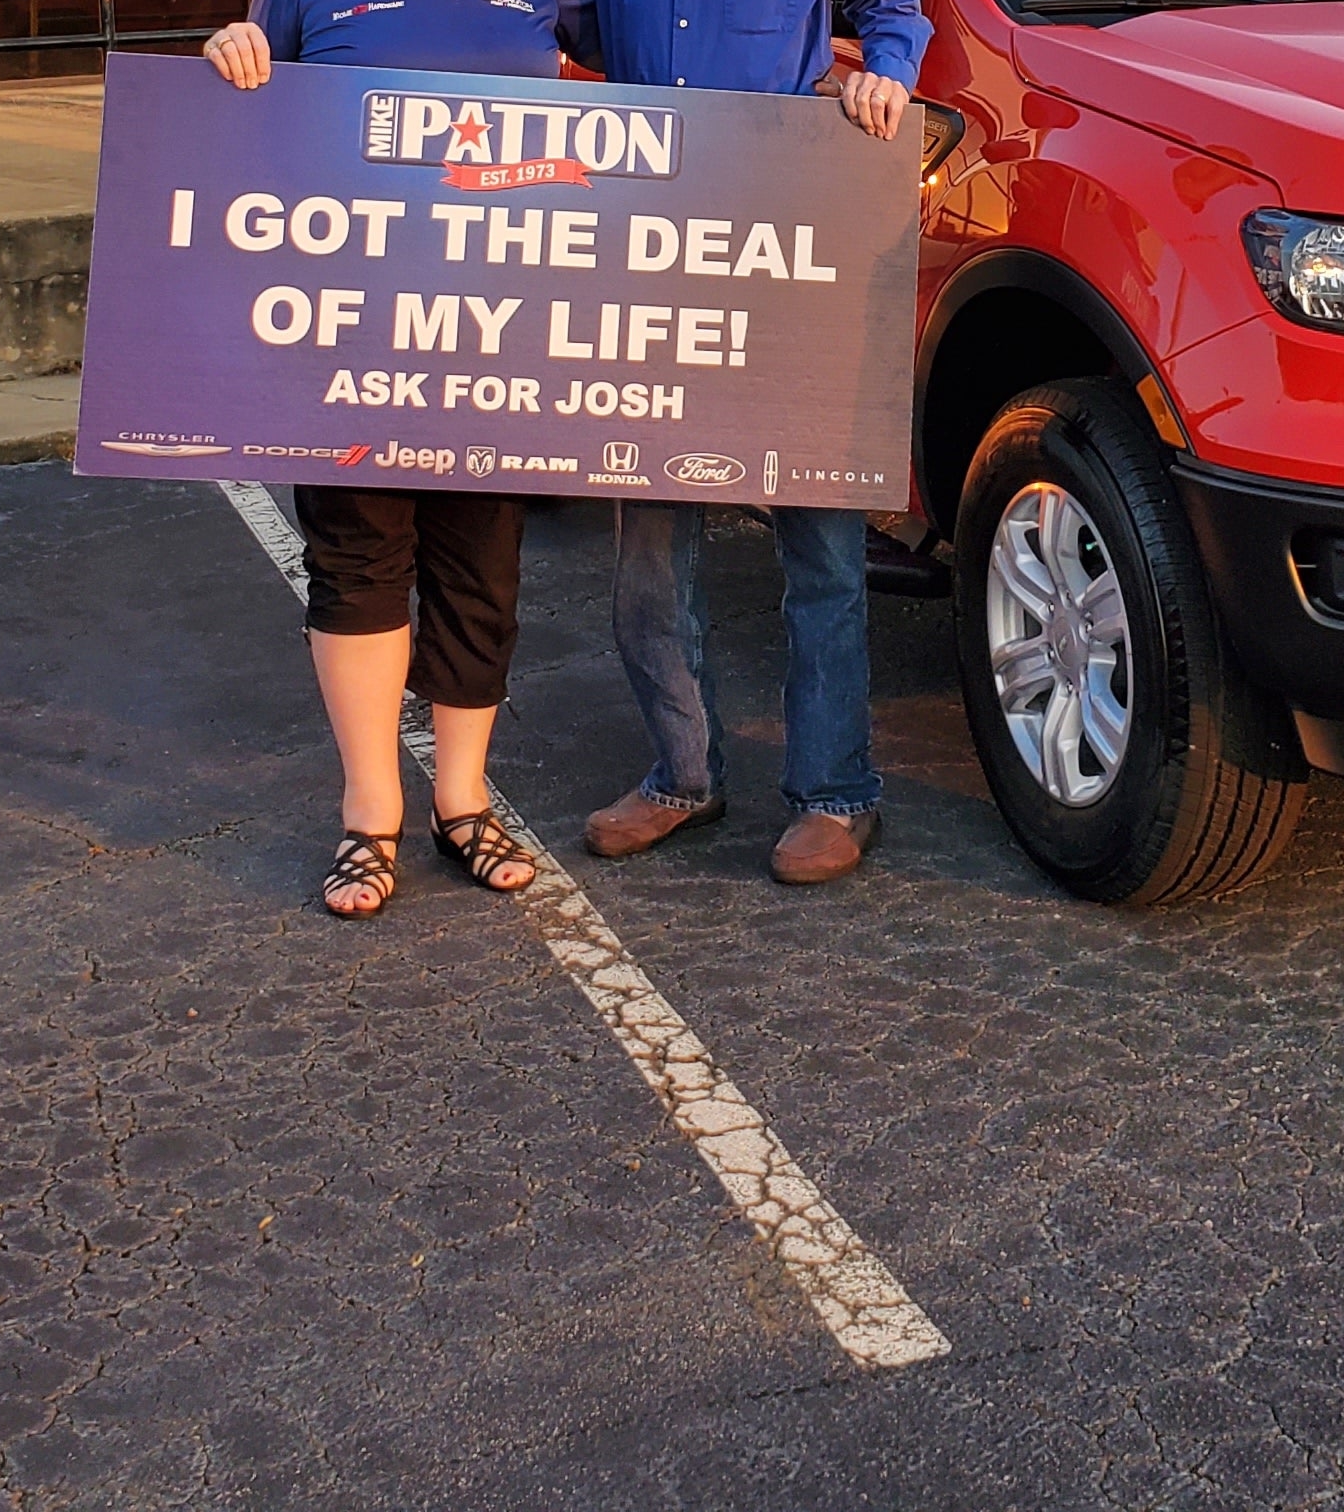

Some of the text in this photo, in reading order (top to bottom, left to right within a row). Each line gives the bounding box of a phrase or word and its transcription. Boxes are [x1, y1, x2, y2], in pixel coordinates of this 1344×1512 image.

[368, 95, 673, 175] MIKE PATTON
[480, 163, 556, 186] EST. 1973
[168, 189, 838, 282] I GOT THE DEAL
[253, 285, 749, 367] OF MY LIFE!
[324, 370, 684, 420] ASK FOR JOSH
[118, 431, 885, 486] CHRYSLER DODGE Jeep RAM HONDA Ford LINCOLN
